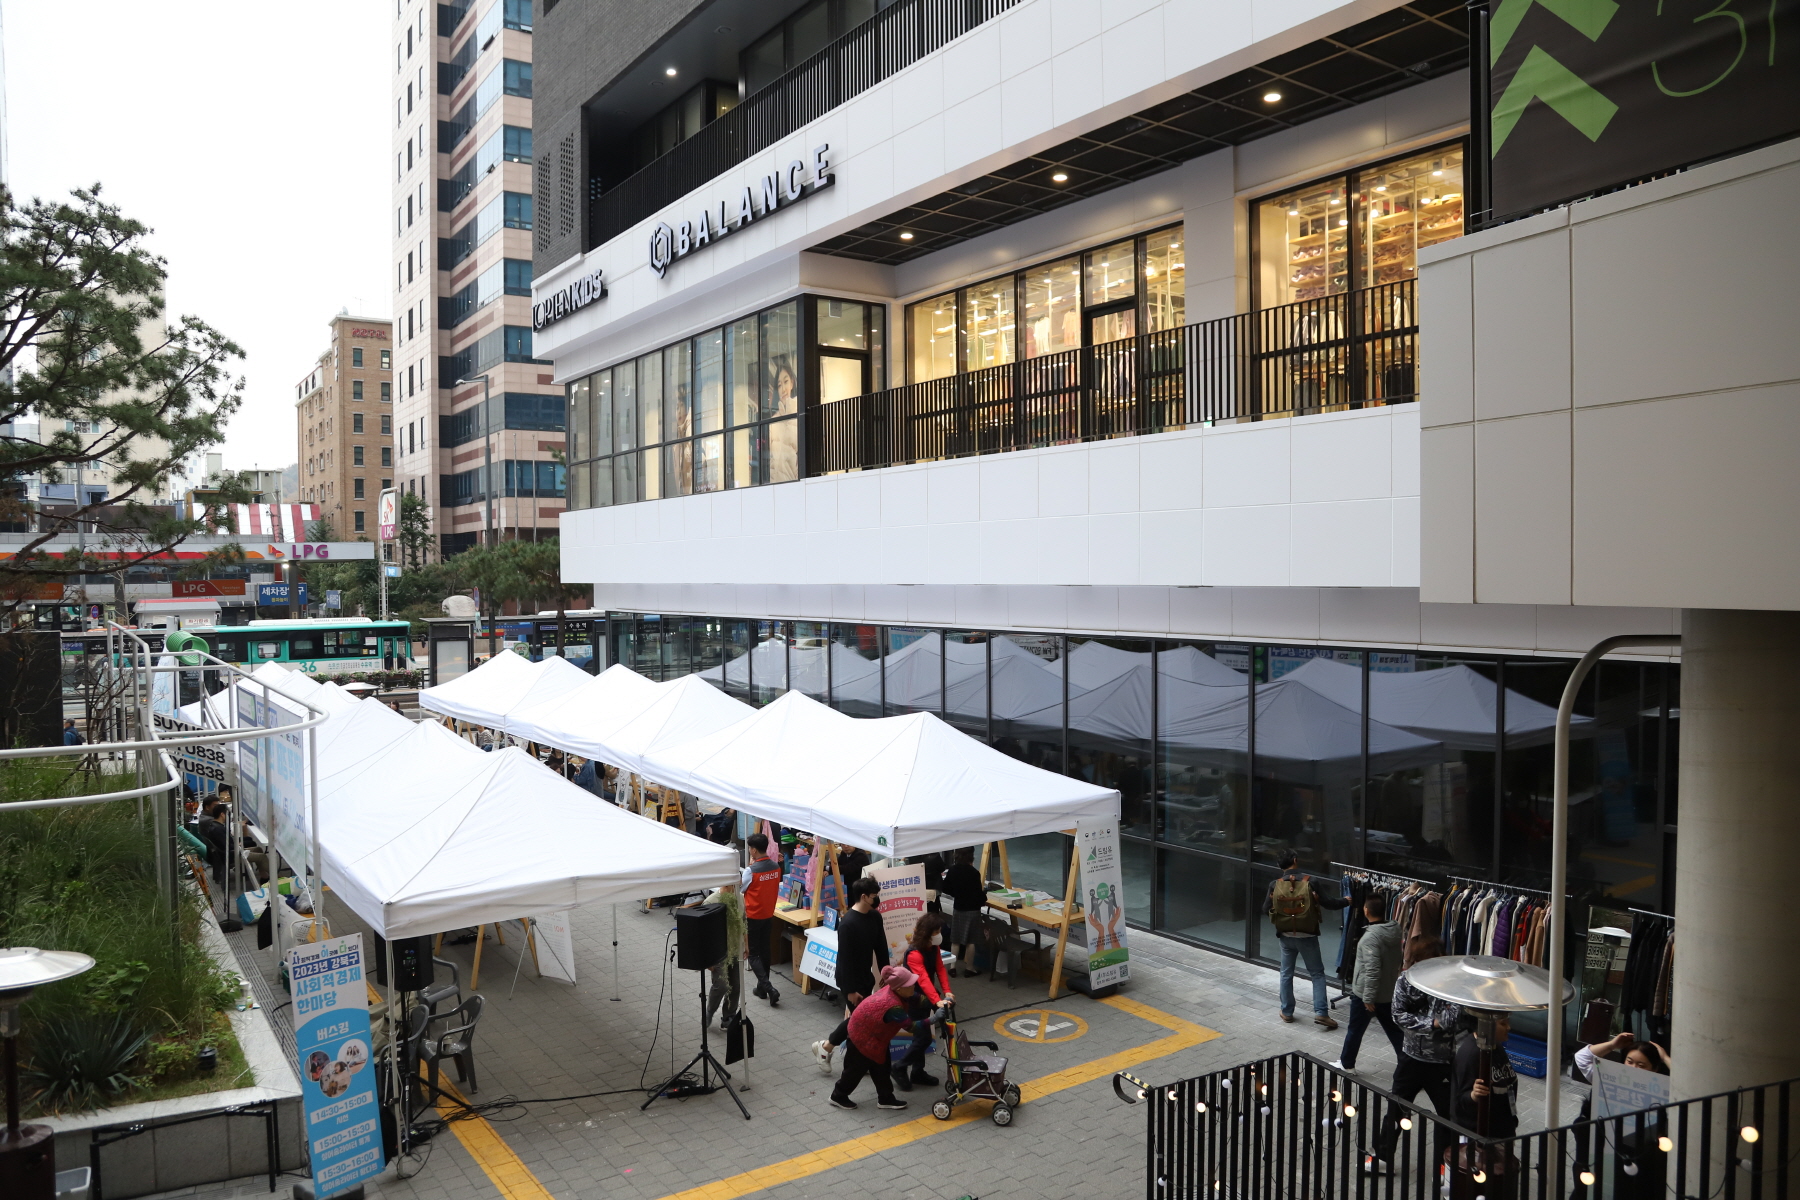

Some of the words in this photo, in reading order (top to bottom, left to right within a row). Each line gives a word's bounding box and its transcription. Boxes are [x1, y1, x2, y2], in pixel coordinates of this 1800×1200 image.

[677, 143, 832, 256] BALANCE
[384, 525, 394, 538] LPG
[292, 544, 329, 559] LPG
[182, 583, 206, 593] LPG
[261, 586, 305, 596] 세차장구
[299, 661, 317, 673] 36
[294, 960, 329, 979] 2023년
[331, 952, 358, 970] 강북구
[296, 966, 362, 997] 사회적경제
[297, 990, 338, 1016] 한마당
[316, 1021, 349, 1041] 버스킹
